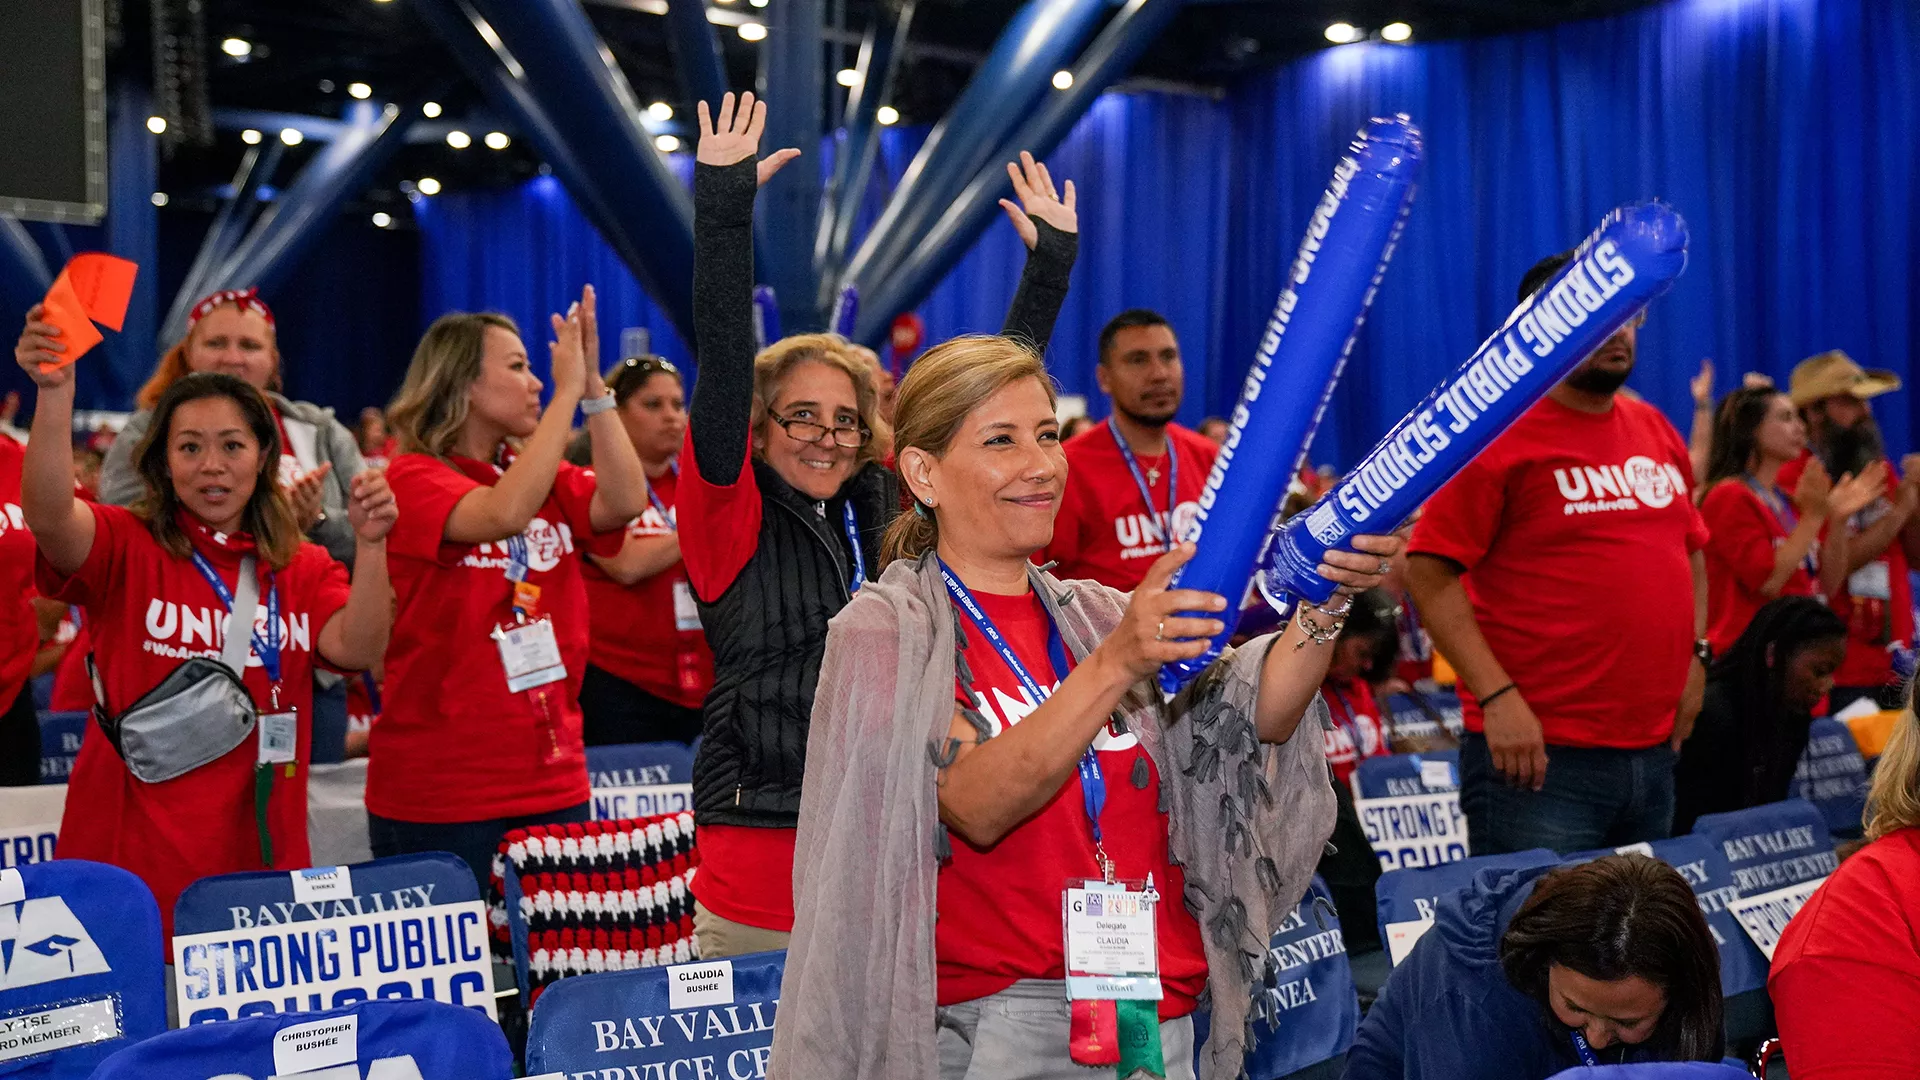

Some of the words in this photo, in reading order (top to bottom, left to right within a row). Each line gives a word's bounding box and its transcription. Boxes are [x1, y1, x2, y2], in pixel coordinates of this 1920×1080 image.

[1518, 240, 1636, 358] STRONG
[1436, 332, 1534, 434] PUBLIC
[1337, 410, 1452, 523] SCHOOLS
[1315, 519, 1346, 546] nea
[1363, 801, 1448, 844] STRONG
[228, 902, 299, 930] BAY
[303, 883, 436, 920] VALLEY
[1073, 900, 1082, 912] G
[1096, 921, 1127, 930] Delegate
[1096, 937, 1130, 945] CLAUDIA
[1272, 928, 1347, 974] ENTER
[182, 928, 341, 1000] STRONG
[350, 912, 482, 976] PUBLIC
[679, 969, 724, 981] CLAUDIA
[686, 983, 719, 993] BUSHÉE
[1096, 984, 1134, 992] DELEGATE
[18, 1014, 51, 1029] TSE
[592, 1015, 665, 1052] BAY
[671, 1000, 780, 1043] VALL
[22, 1025, 81, 1046] MEMBER
[281, 1023, 352, 1042] CHRISTOPHER
[296, 1037, 338, 1052] BUSHÉE
